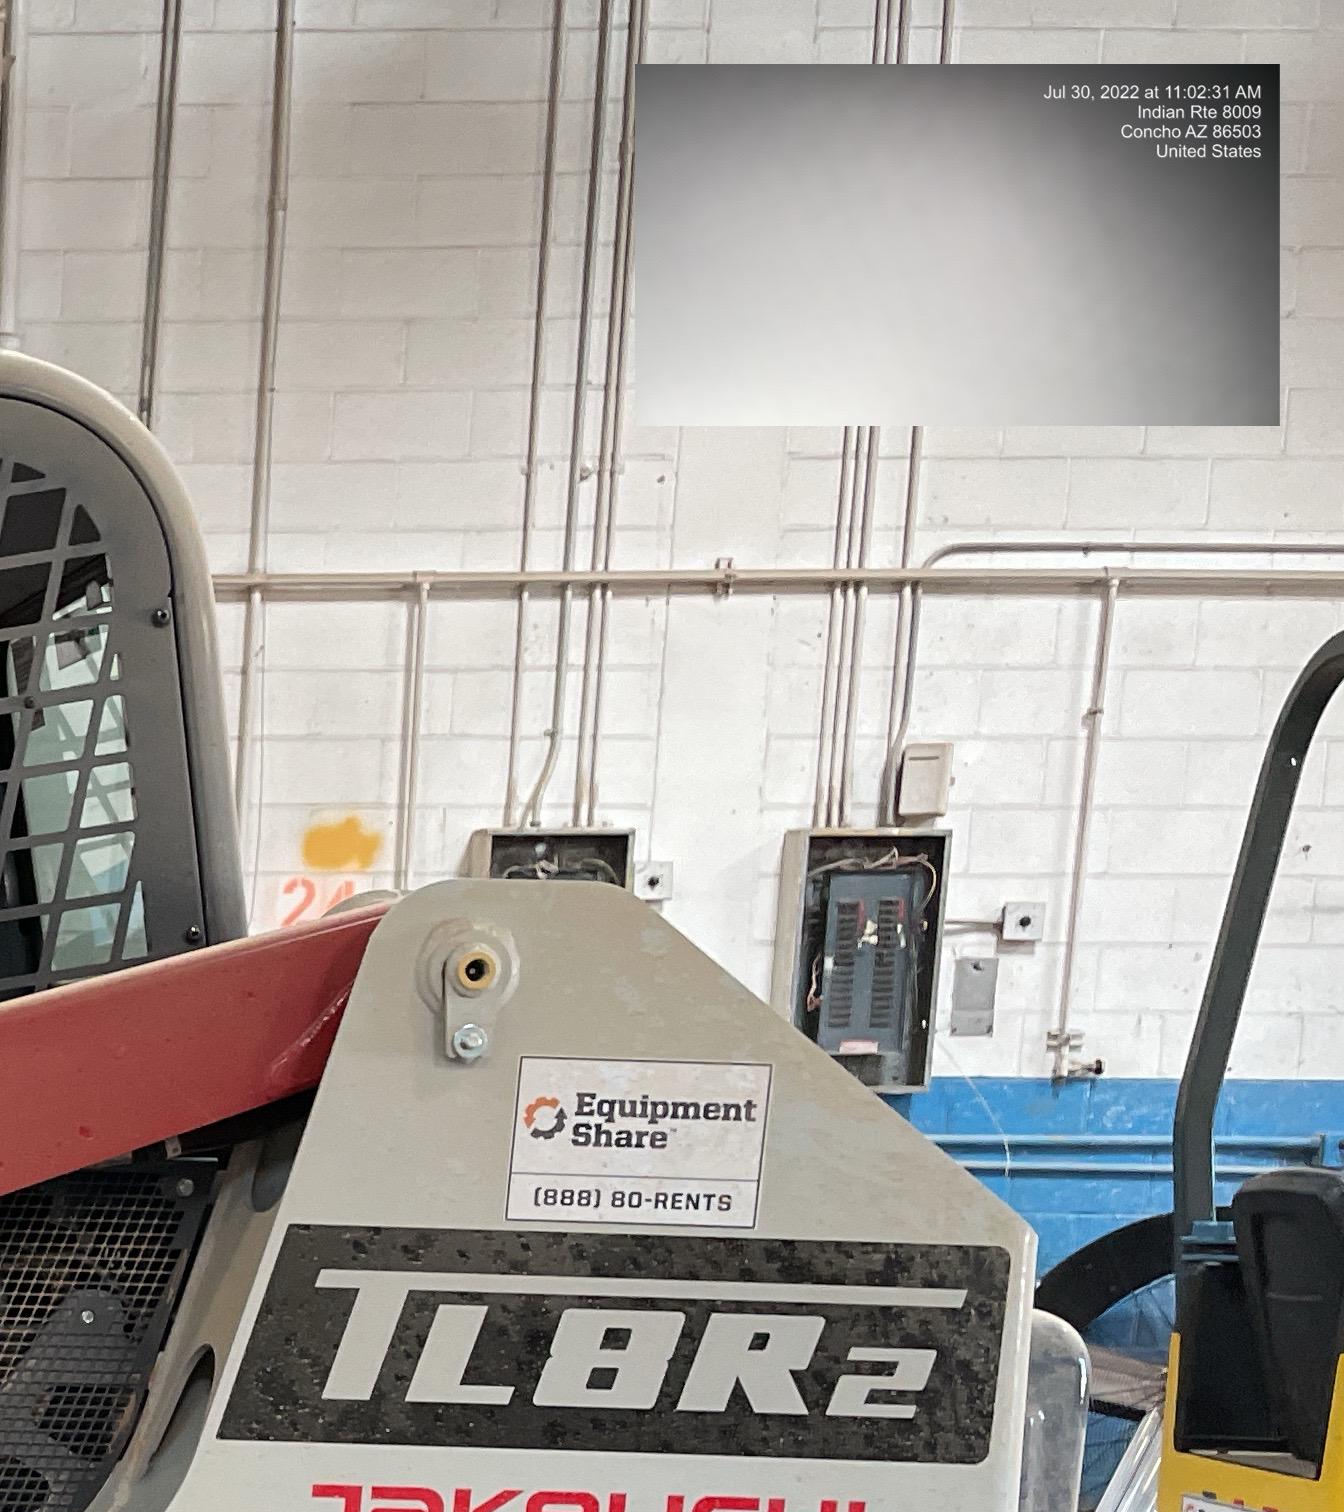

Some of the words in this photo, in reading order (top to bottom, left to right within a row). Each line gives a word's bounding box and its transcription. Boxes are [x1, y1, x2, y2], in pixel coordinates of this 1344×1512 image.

[574, 1092, 757, 1125] Equipment
[572, 1123, 668, 1149] Share
[534, 1187, 601, 1208] (888)
[611, 1190, 733, 1212] 80-RENTS
